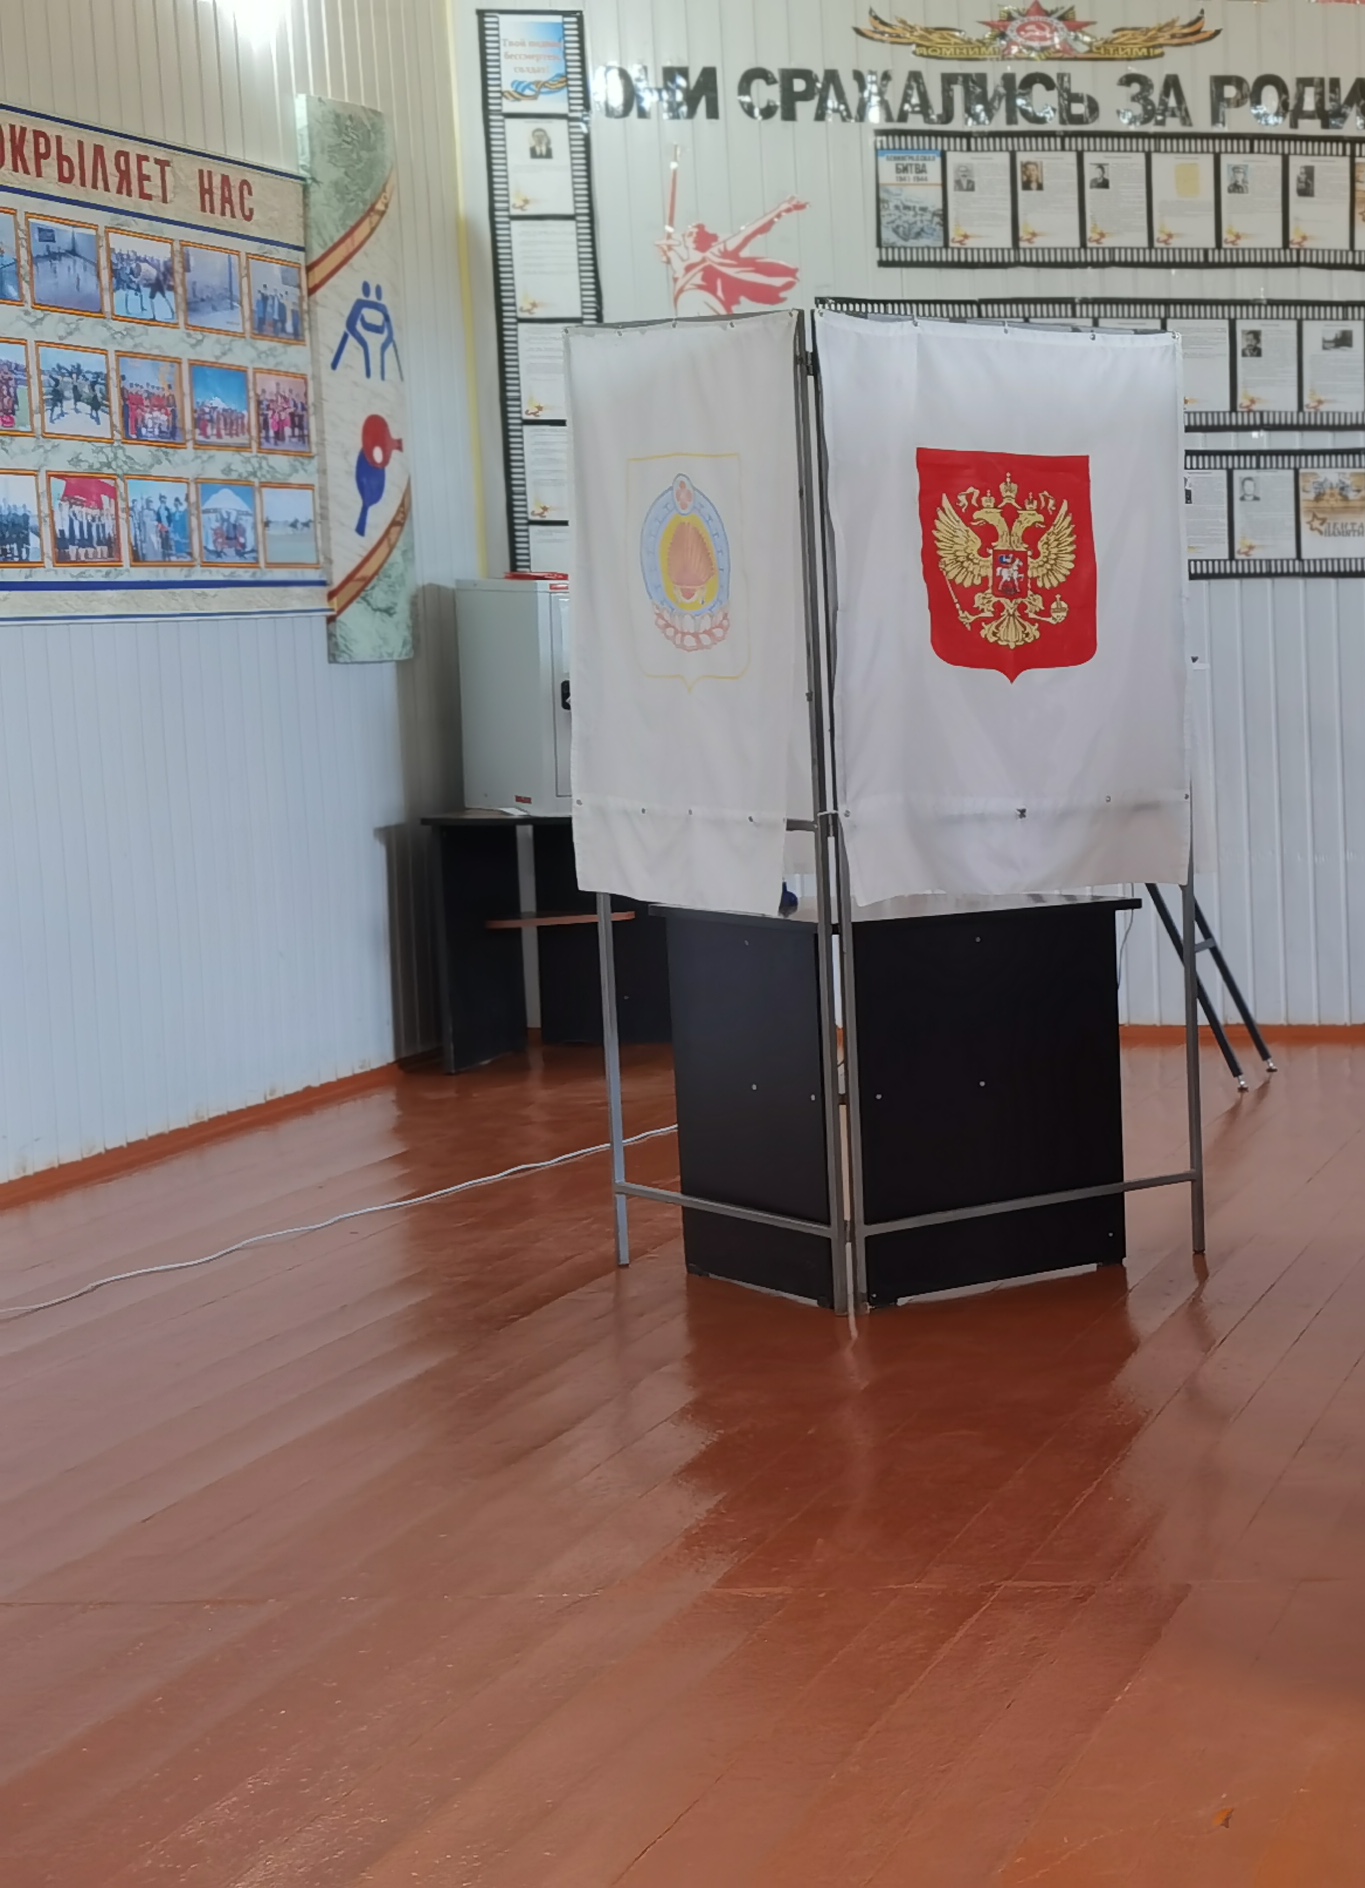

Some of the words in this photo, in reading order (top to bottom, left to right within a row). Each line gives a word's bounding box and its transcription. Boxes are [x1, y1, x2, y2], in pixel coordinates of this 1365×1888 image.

[593, 64, 720, 121] ОНИ
[737, 66, 1100, 126] СРАЖАЛИСЬ
[1116, 72, 1194, 127] ЗА
[0, 124, 171, 204] КРЫЛЯЕТ
[198, 169, 255, 222] НАС
[895, 163, 927, 174] БИТВА
